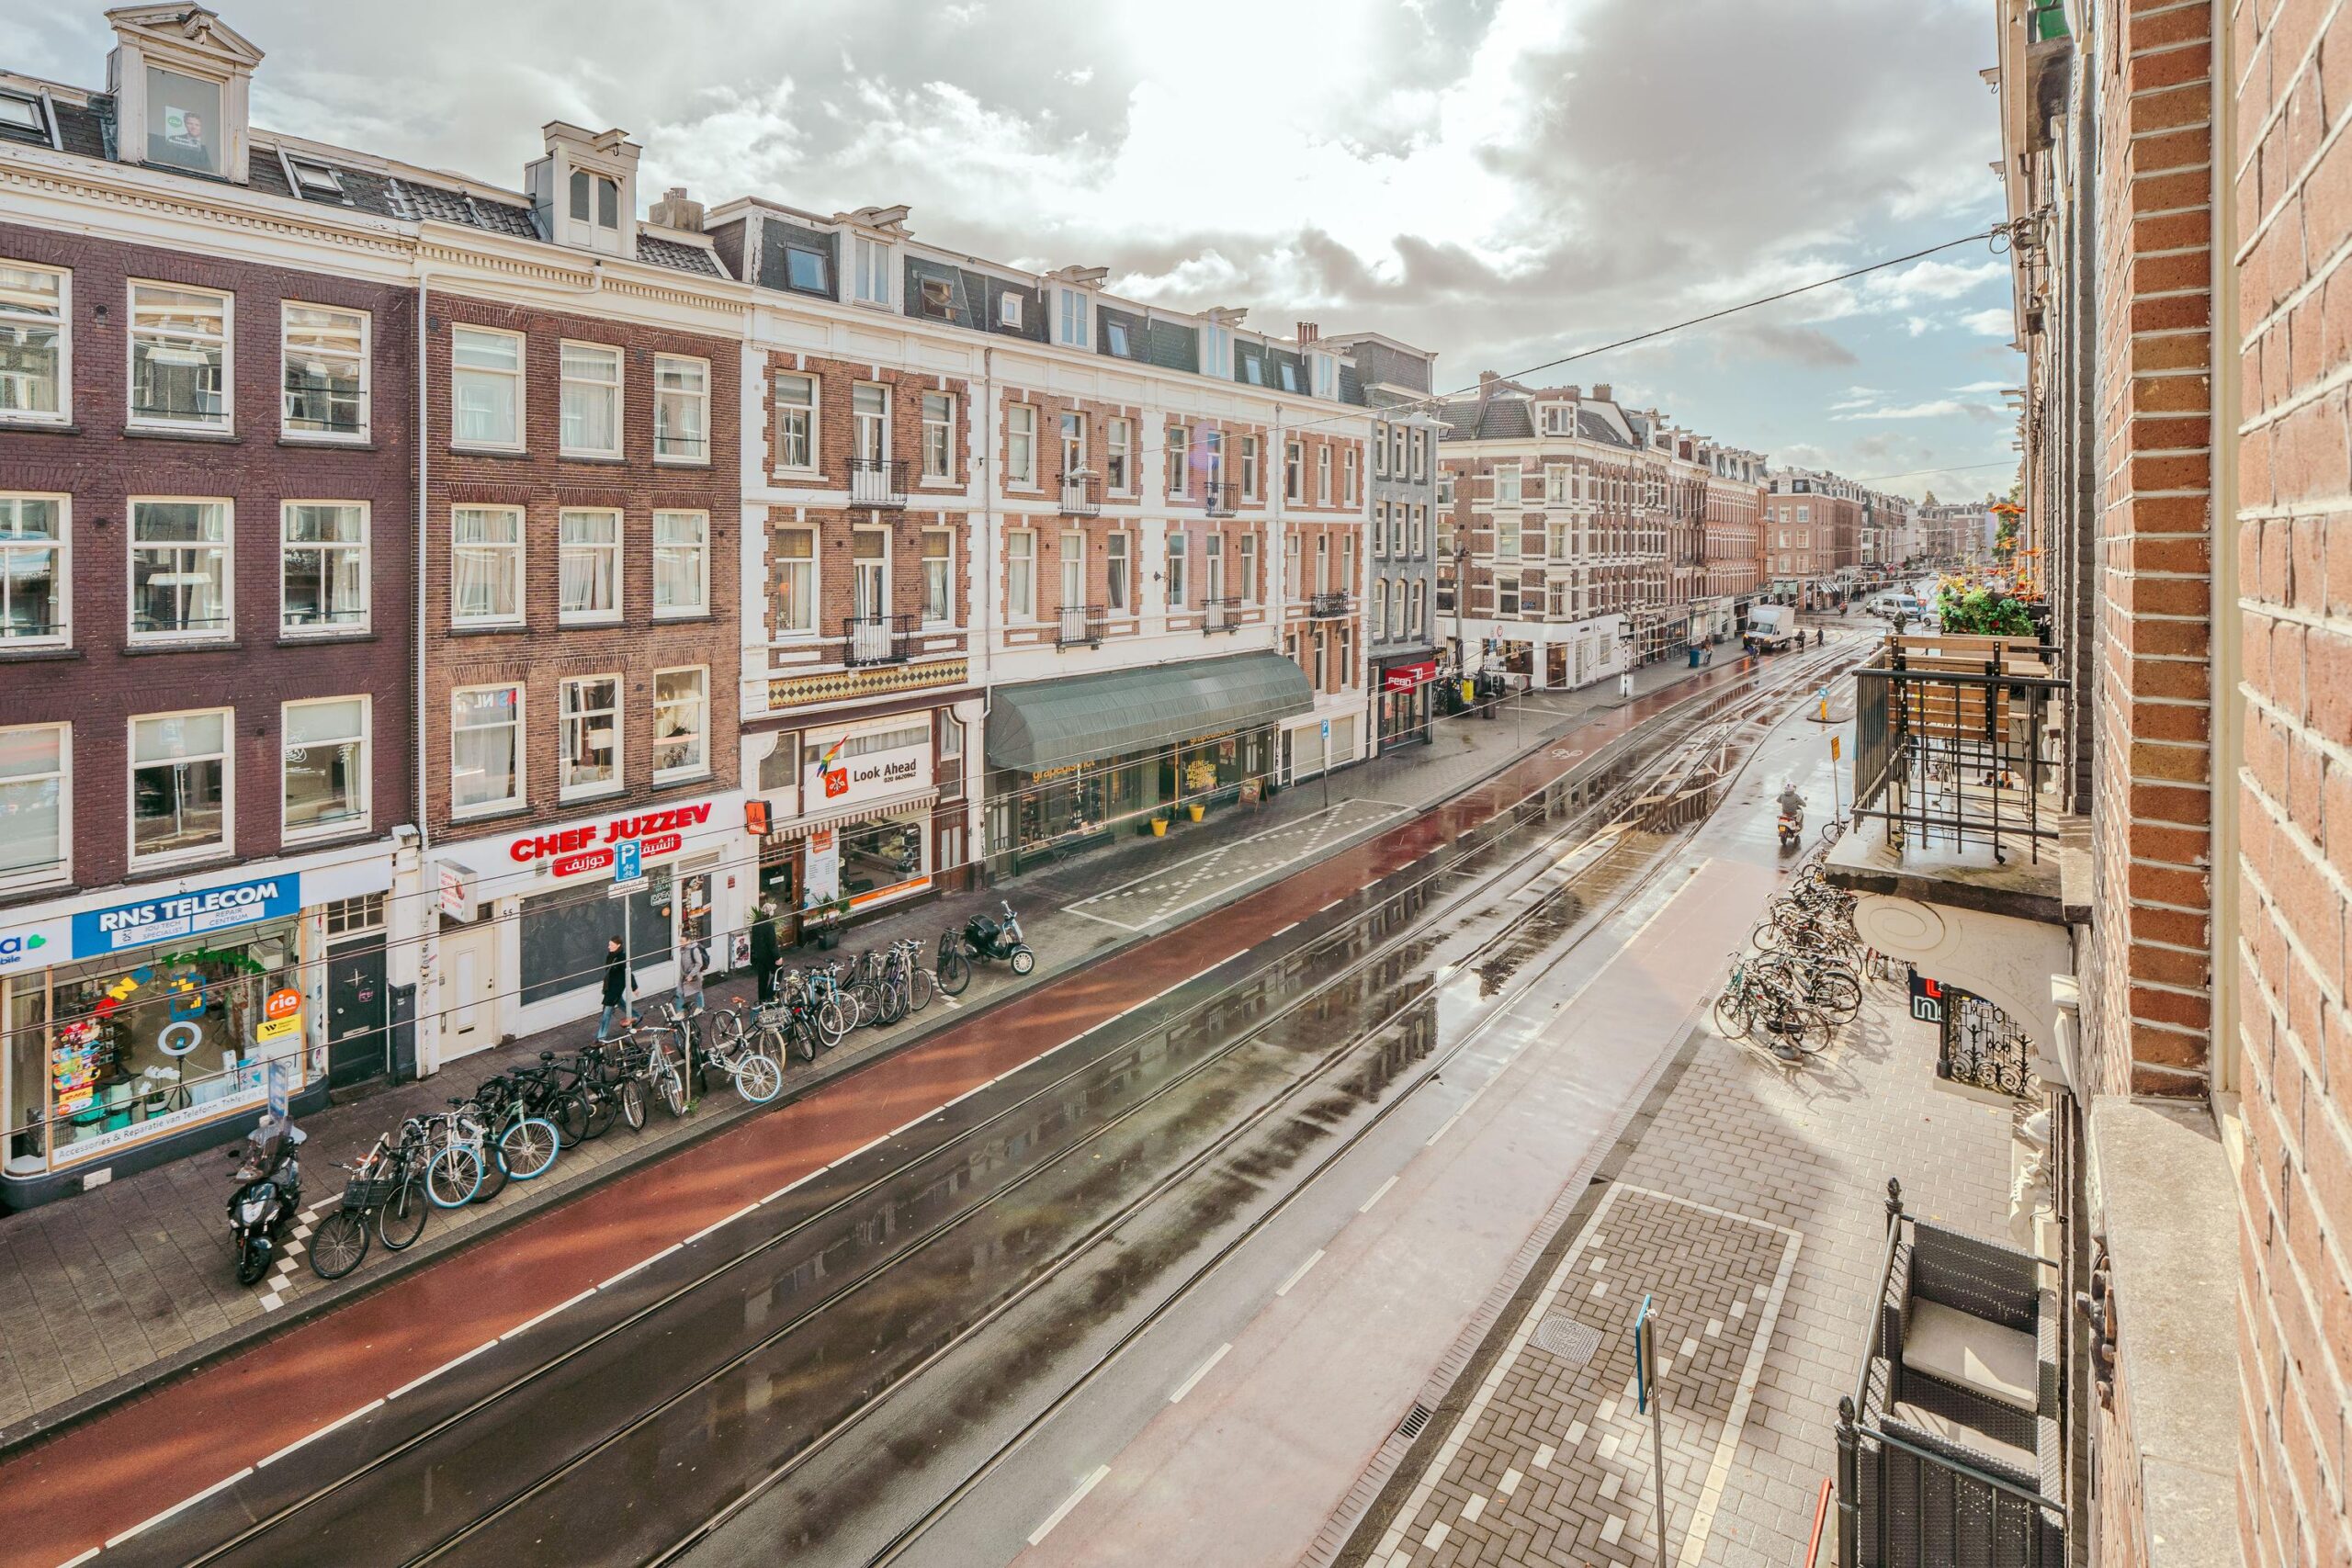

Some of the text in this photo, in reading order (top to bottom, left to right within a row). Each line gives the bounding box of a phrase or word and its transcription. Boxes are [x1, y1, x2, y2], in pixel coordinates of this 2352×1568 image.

[1388, 676, 1411, 687] FEBO
[854, 758, 916, 783] Look Ahead
[510, 826, 596, 863] CHEF
[621, 843, 636, 865] P
[99, 882, 278, 932] RNS TELECOM
[215, 907, 243, 919] REPAIR
[209, 913, 248, 927] CENTRUM
[142, 927, 183, 941] SPECIALIST
[270, 993, 298, 1012] ria
[59, 1138, 110, 1159] Accessories
[113, 1134, 121, 1142] &
[124, 1120, 164, 1138] Reparatie
[166, 1115, 181, 1125] van
